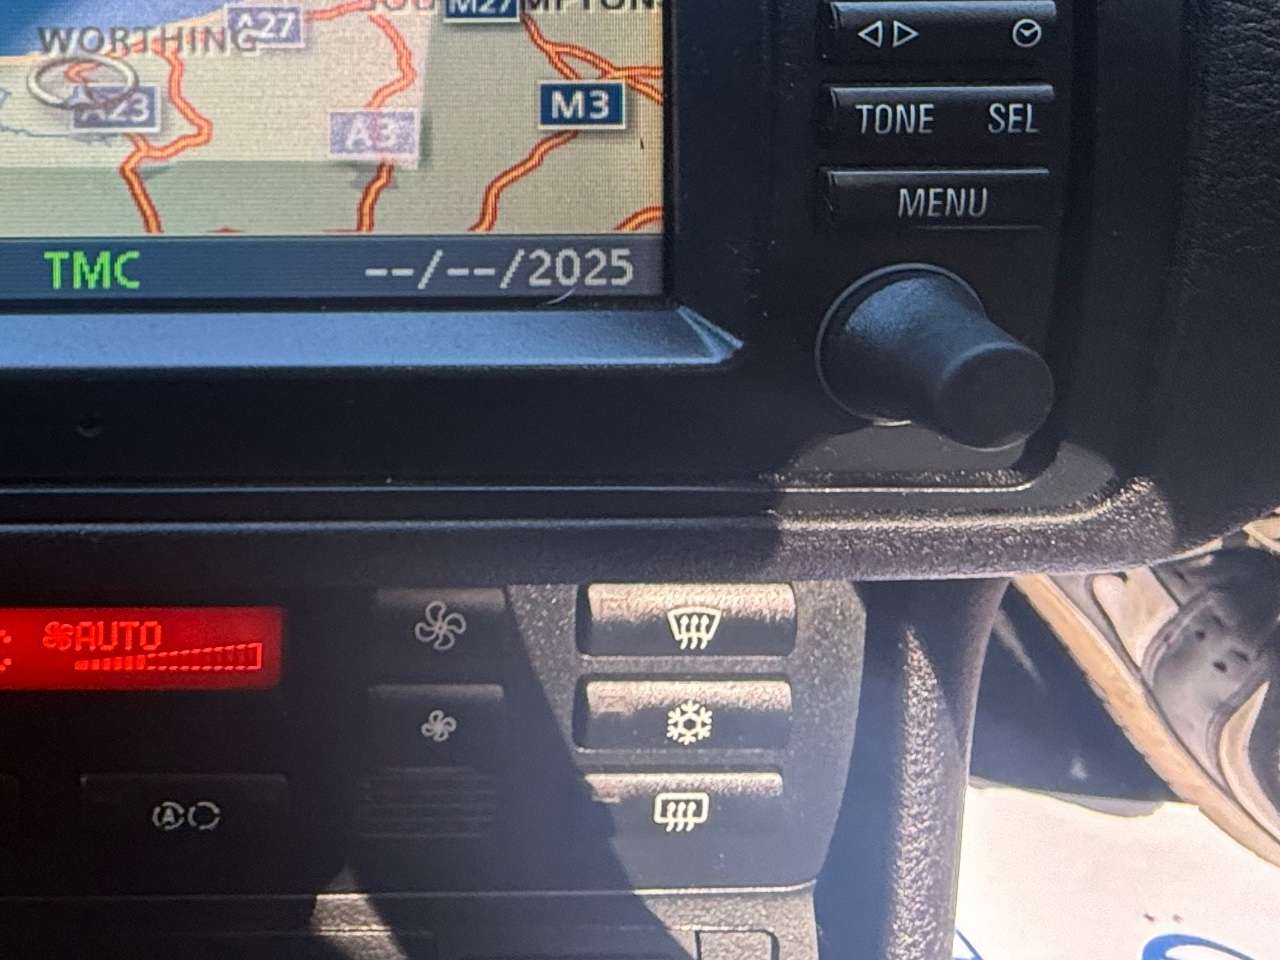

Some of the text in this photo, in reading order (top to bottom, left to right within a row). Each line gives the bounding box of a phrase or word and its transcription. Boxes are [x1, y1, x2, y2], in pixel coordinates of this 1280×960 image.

[37, 25, 258, 54] WORTHING
[551, 89, 611, 121] M3
[855, 104, 935, 134] TONE
[987, 103, 1040, 134] SEL
[345, 119, 397, 149] A3
[898, 187, 988, 217] MENU
[44, 251, 141, 289] TMC
[74, 621, 162, 651] AUTO
